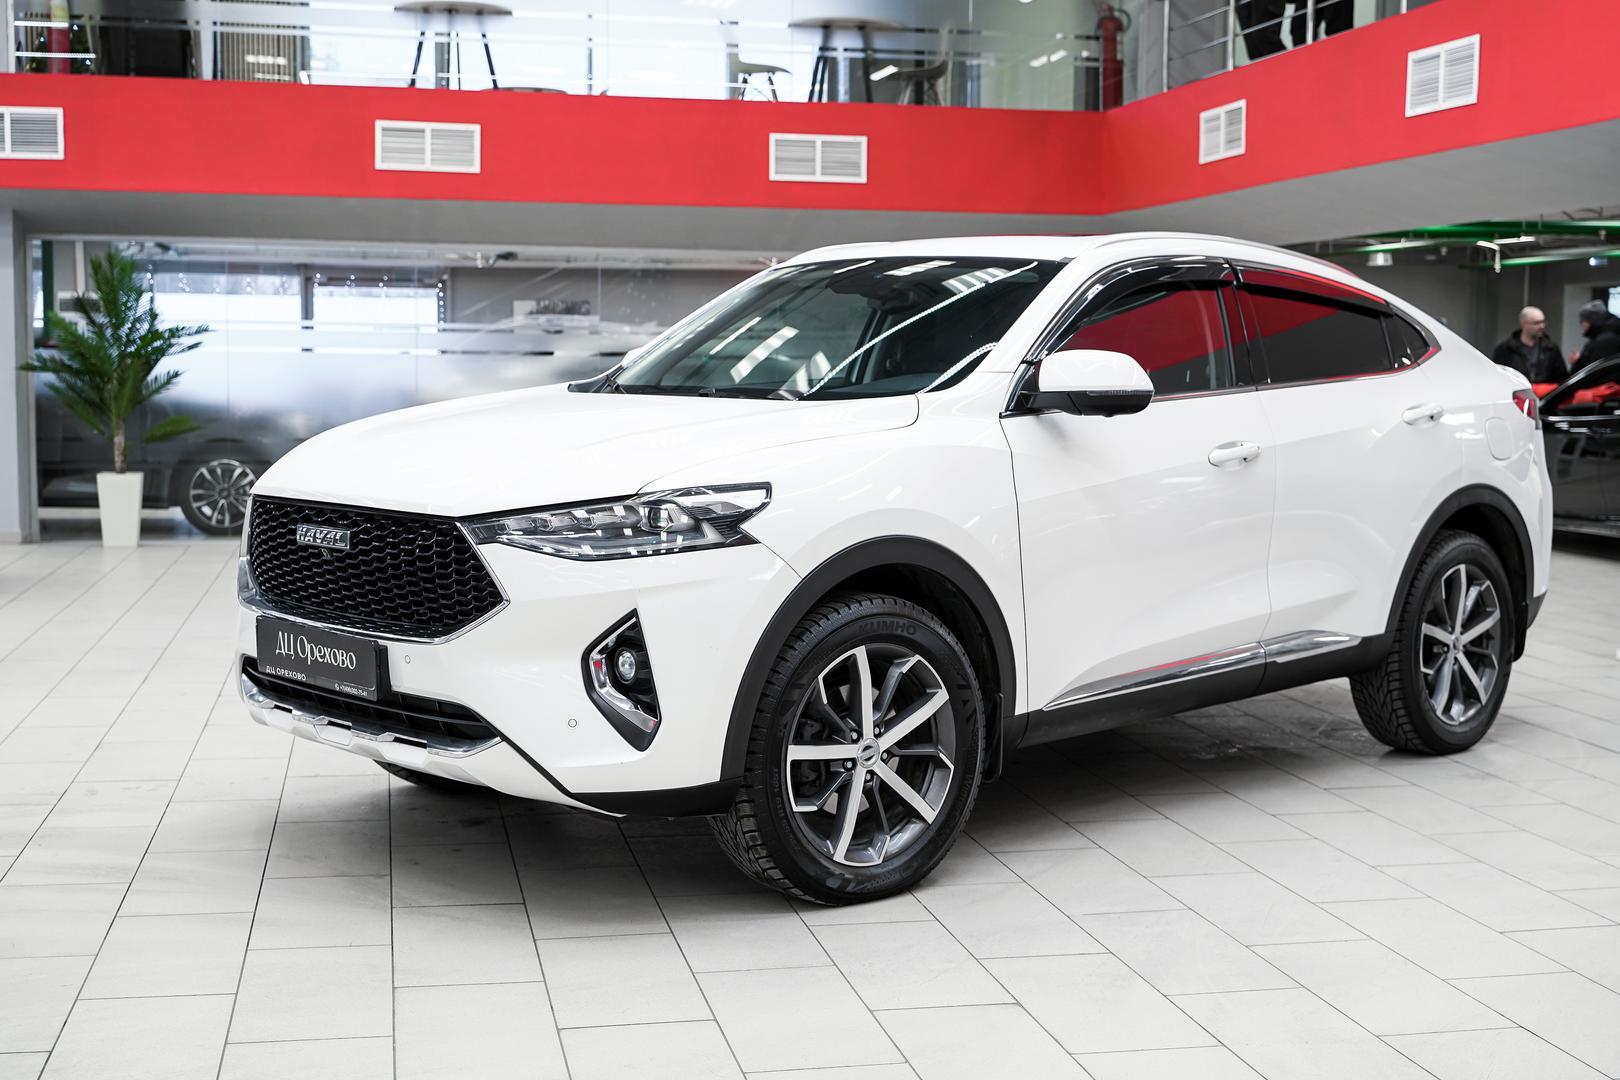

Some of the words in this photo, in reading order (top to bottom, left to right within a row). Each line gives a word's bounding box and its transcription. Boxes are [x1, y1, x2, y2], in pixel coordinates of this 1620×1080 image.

[297, 526, 346, 547] HAVAL
[859, 620, 917, 636] KUMHO
[275, 631, 295, 660] ДЦ
[297, 635, 356, 670] Орехово
[266, 665, 275, 675] ДЦ
[276, 667, 307, 681] ОРЕХОВО
